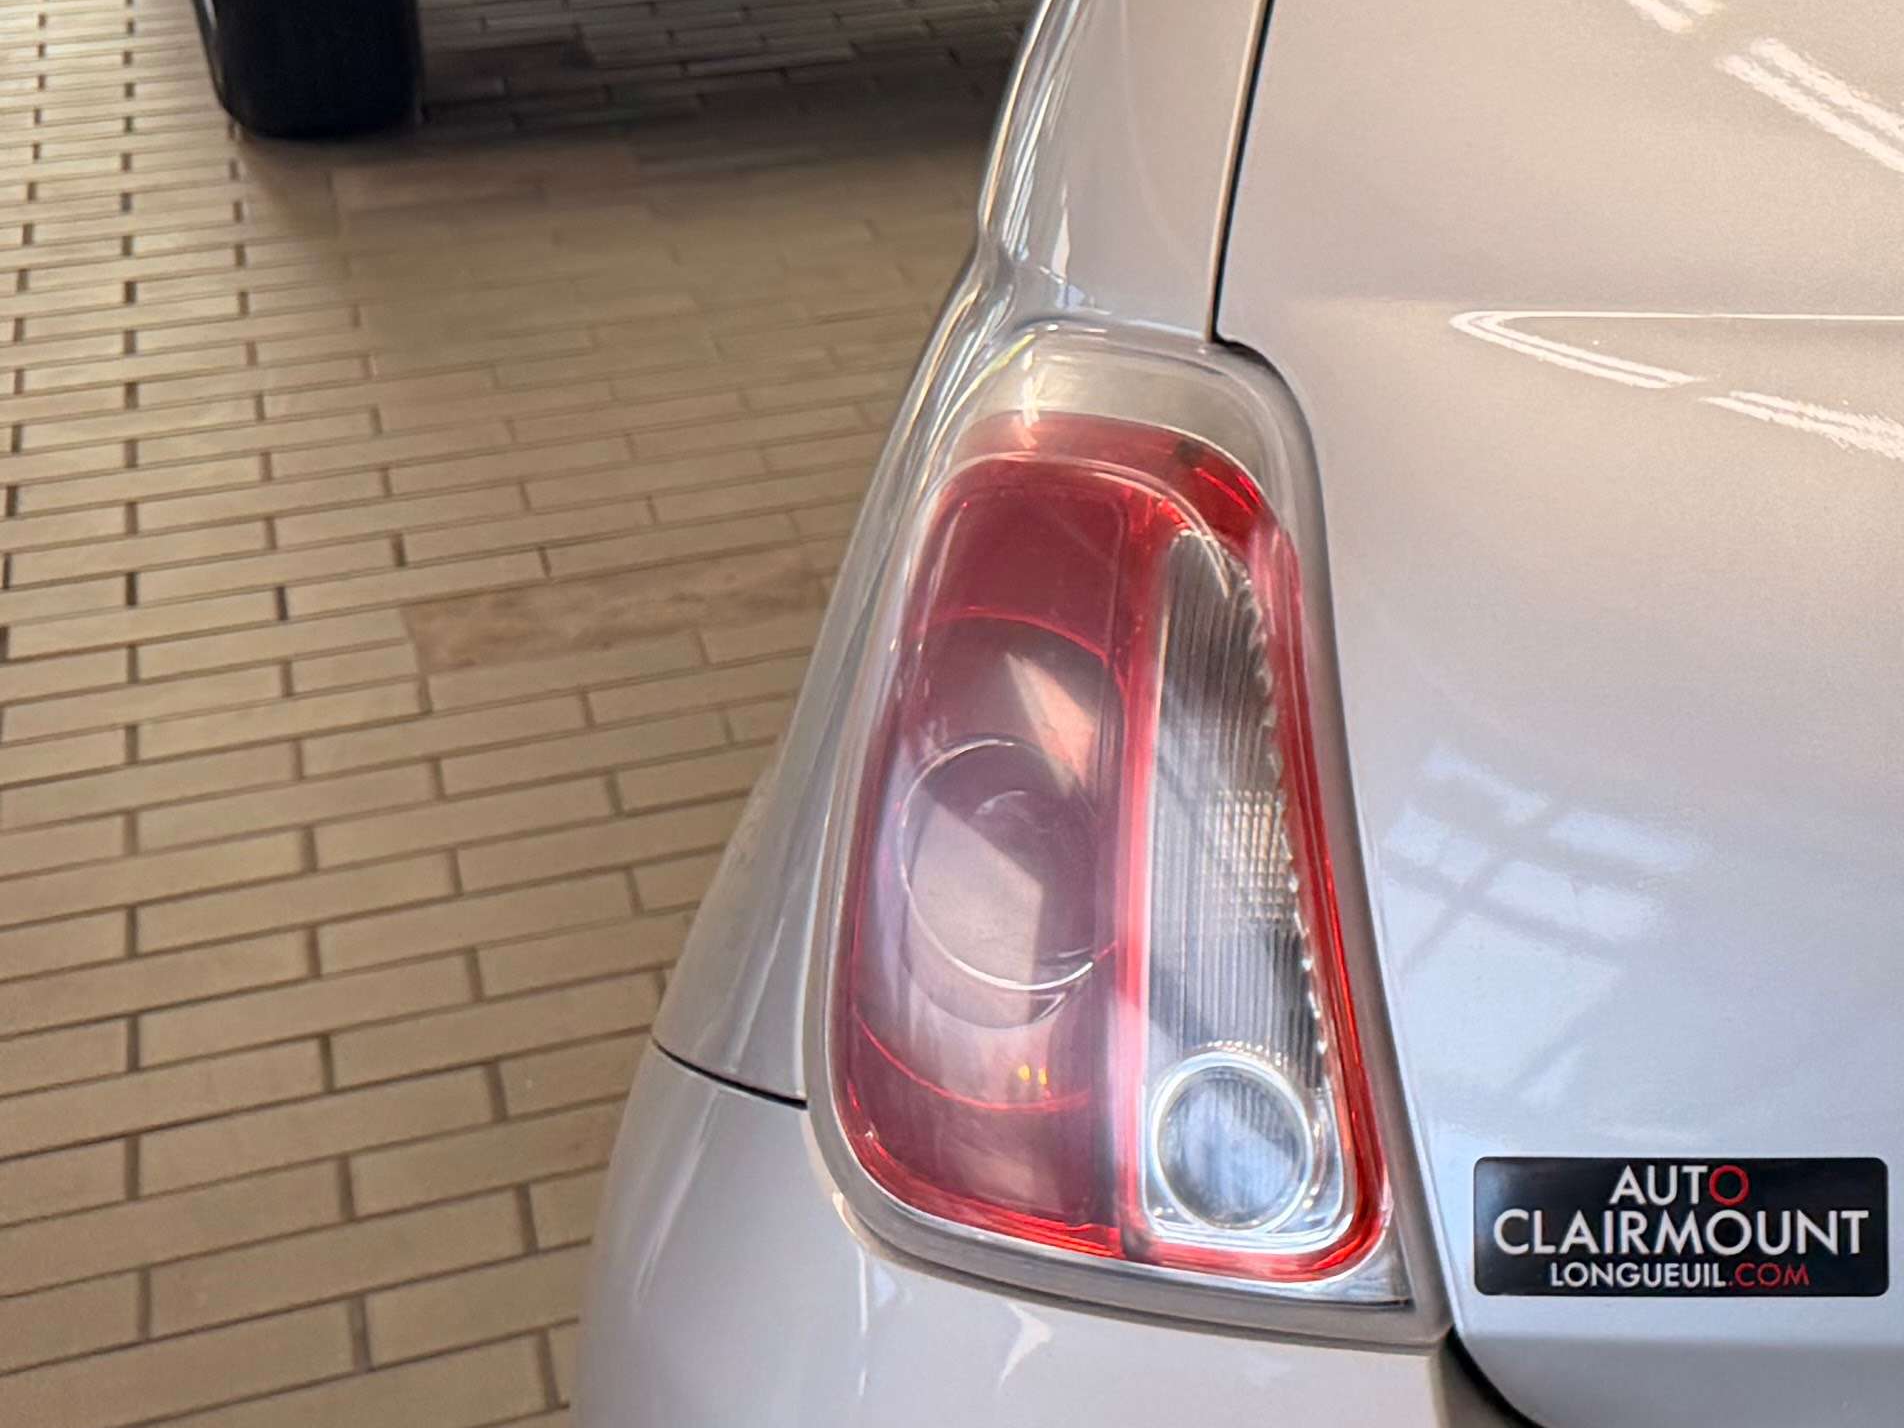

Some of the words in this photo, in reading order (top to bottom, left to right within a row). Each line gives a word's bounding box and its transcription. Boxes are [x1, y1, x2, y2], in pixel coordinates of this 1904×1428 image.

[1609, 1164, 1750, 1206] AUTO
[1493, 1208, 1869, 1256] CLAIRMOUNT
[1550, 1261, 1811, 1288] LONGUEUIL.COM
